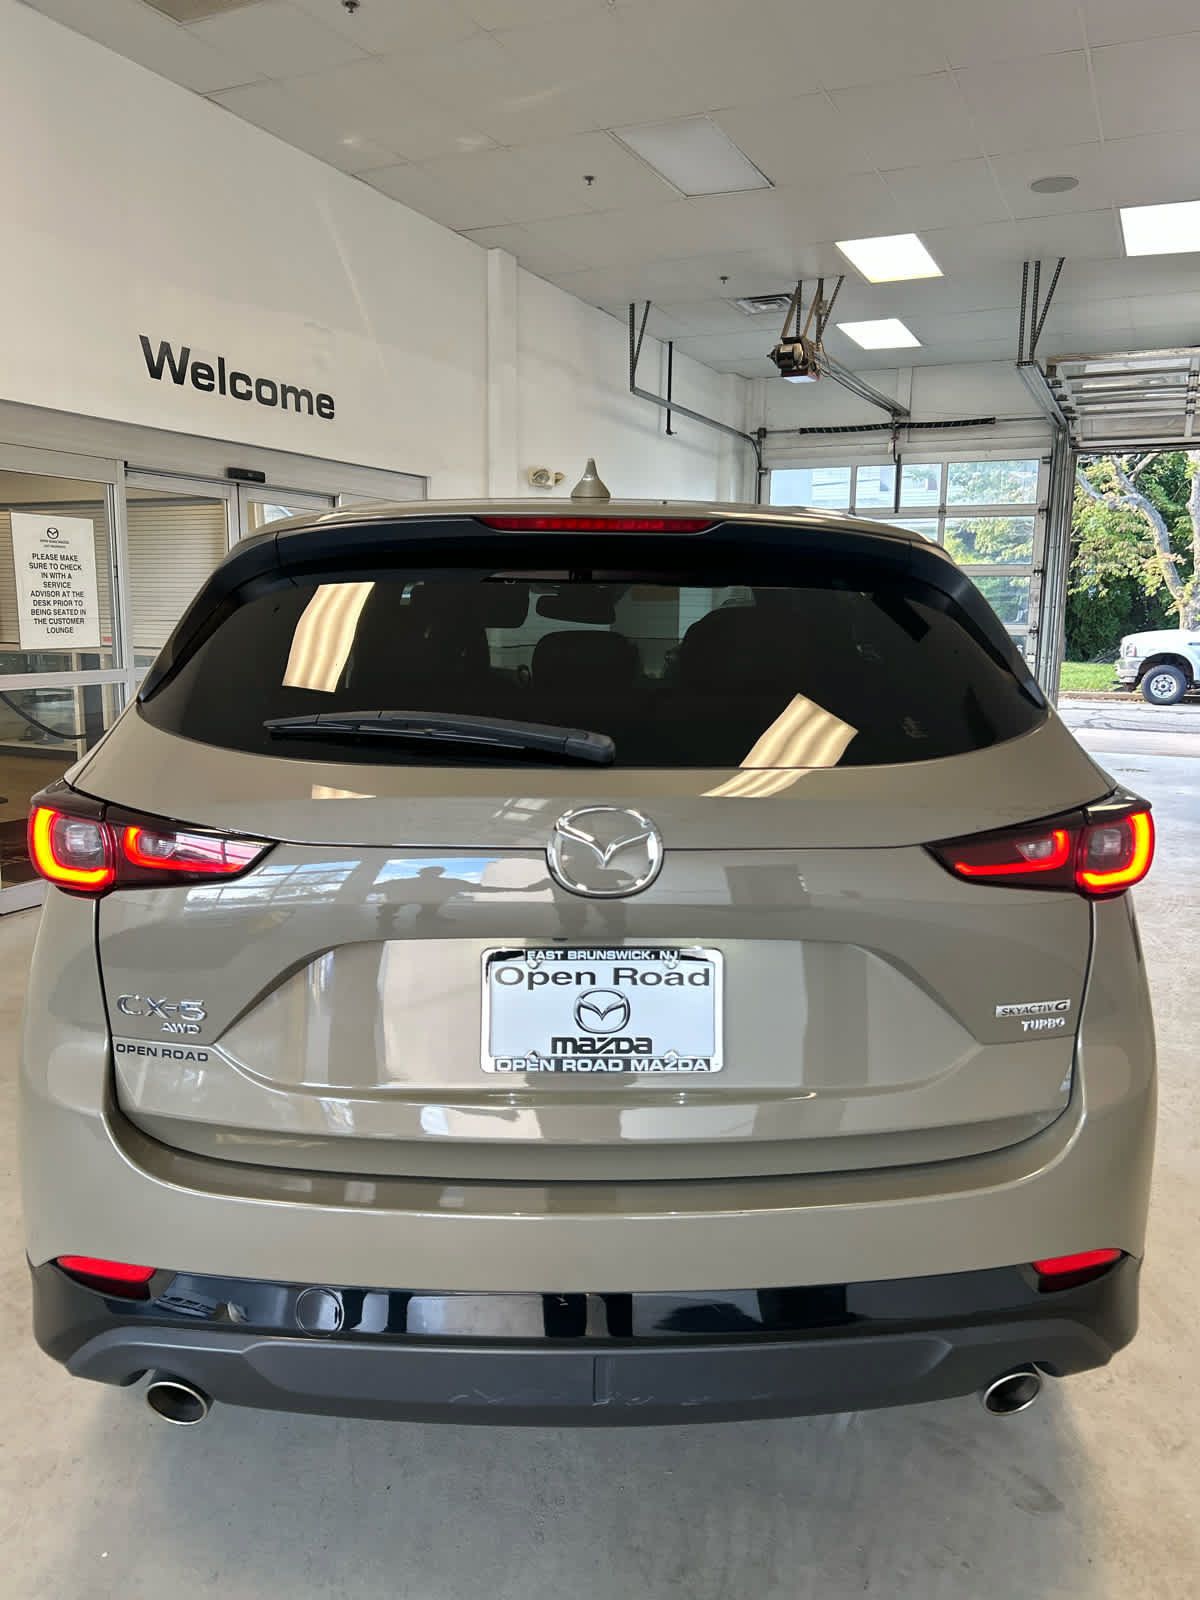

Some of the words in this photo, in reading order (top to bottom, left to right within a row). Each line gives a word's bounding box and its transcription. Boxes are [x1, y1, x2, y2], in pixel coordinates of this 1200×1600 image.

[139, 334, 335, 420] Welcome
[32, 553, 58, 561] PLEASE
[527, 950, 563, 960] EAST
[660, 950, 679, 961] NJ
[495, 966, 596, 990] Open
[613, 967, 710, 986] Road
[117, 994, 207, 1021] CX-5
[161, 1022, 201, 1034] AWD
[1021, 1017, 1065, 1032] TURBO
[116, 1043, 157, 1056] OPEN
[161, 1048, 209, 1062] ROAD
[552, 1037, 652, 1054] mazda
[497, 1059, 555, 1071] OPEN
[562, 1059, 624, 1071] ROAD
[630, 1058, 706, 1071] MAZDA
